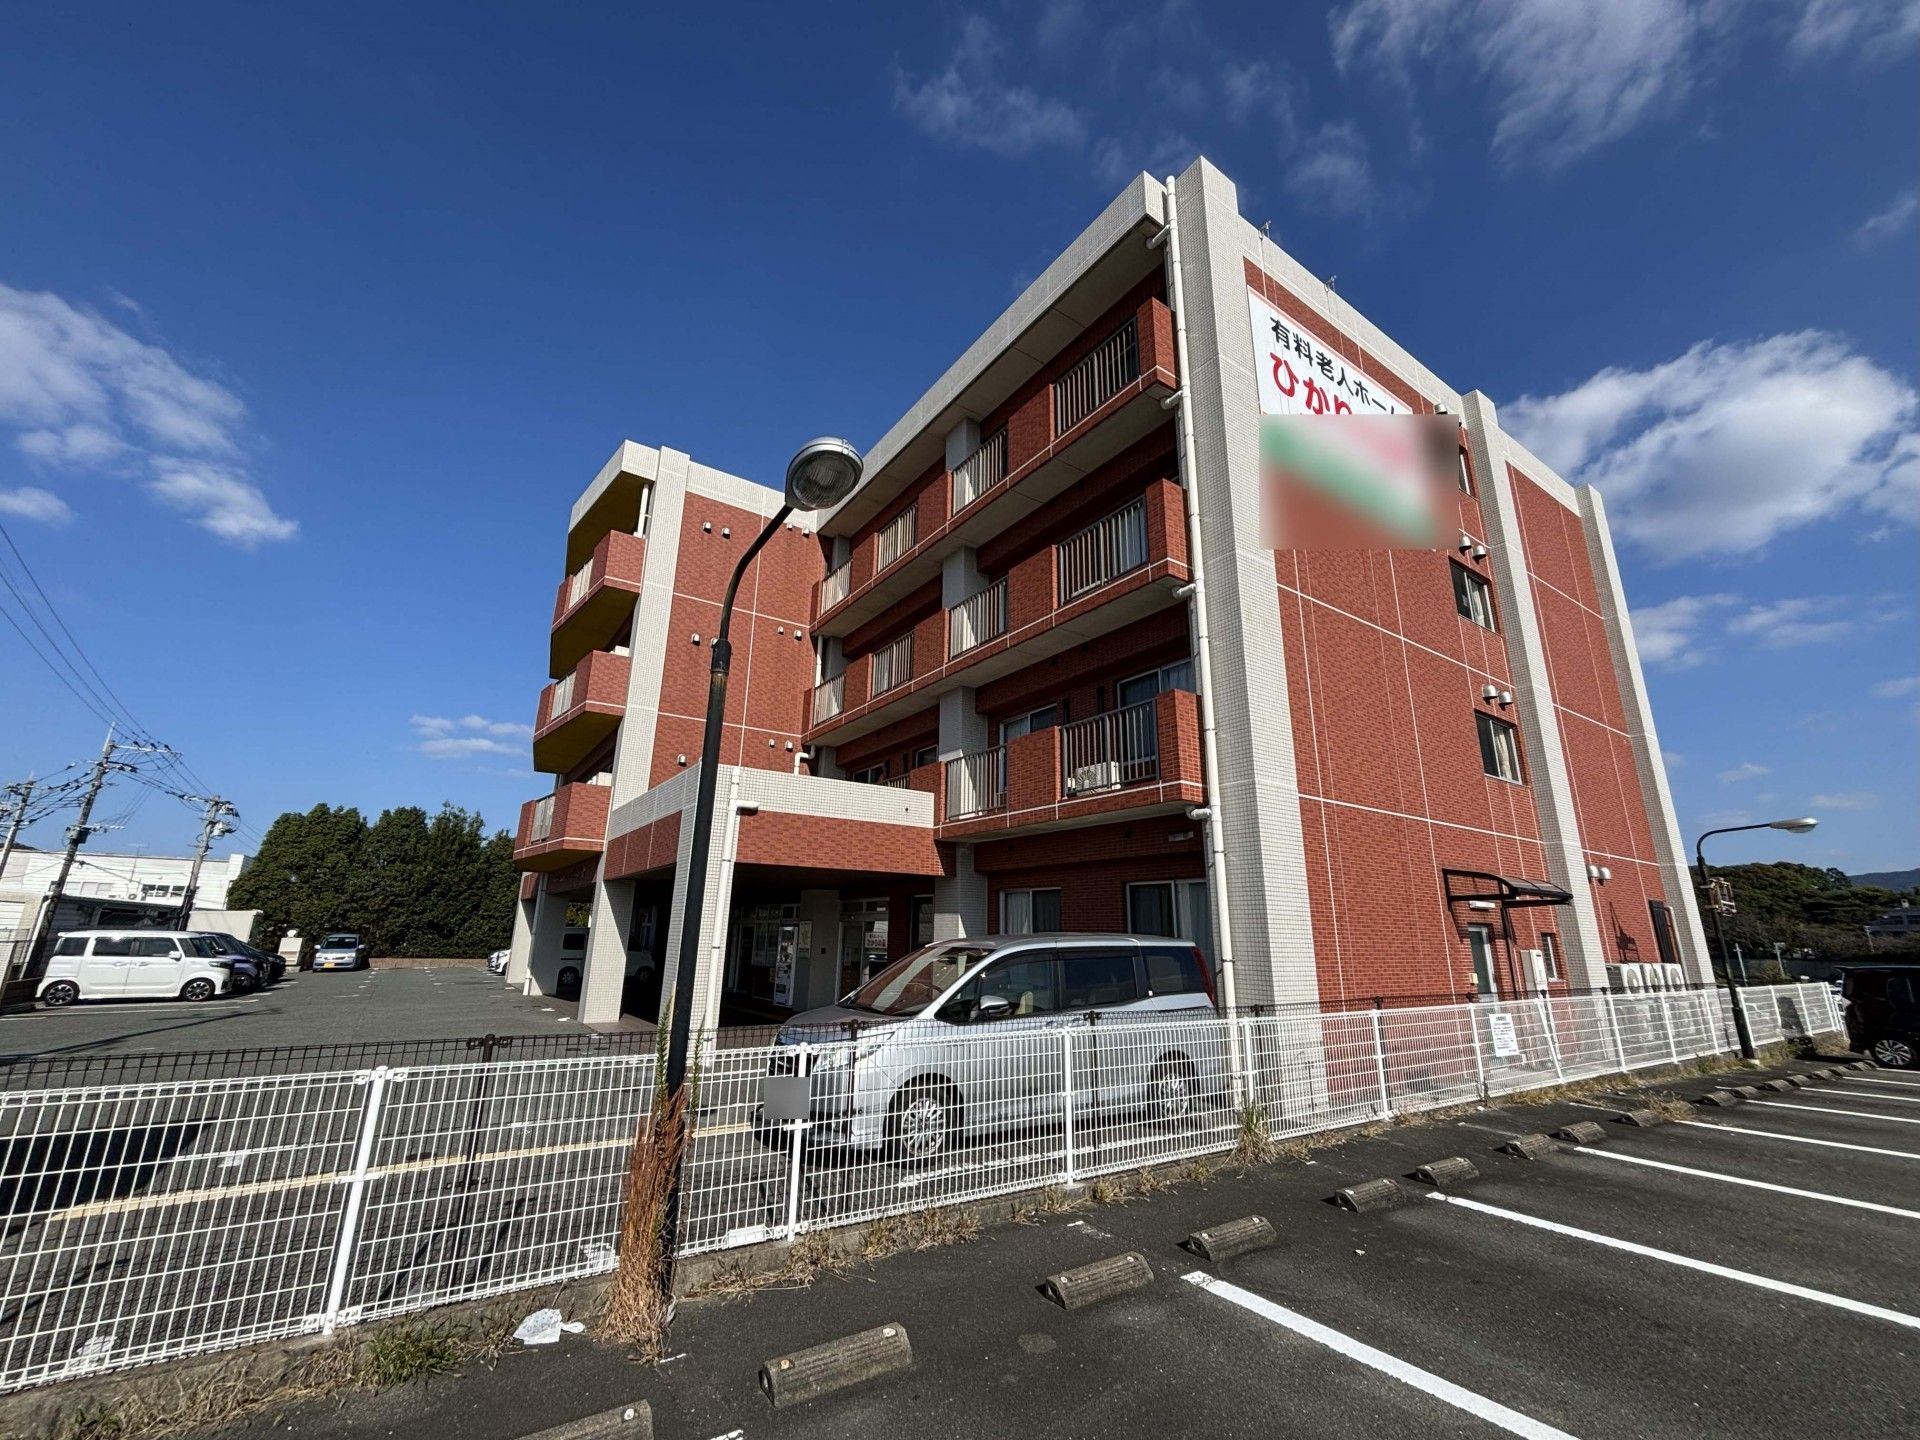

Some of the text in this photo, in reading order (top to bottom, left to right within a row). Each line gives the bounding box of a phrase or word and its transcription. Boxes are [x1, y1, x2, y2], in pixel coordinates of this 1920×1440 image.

[1270, 317, 1394, 414] 有料老人ホー
